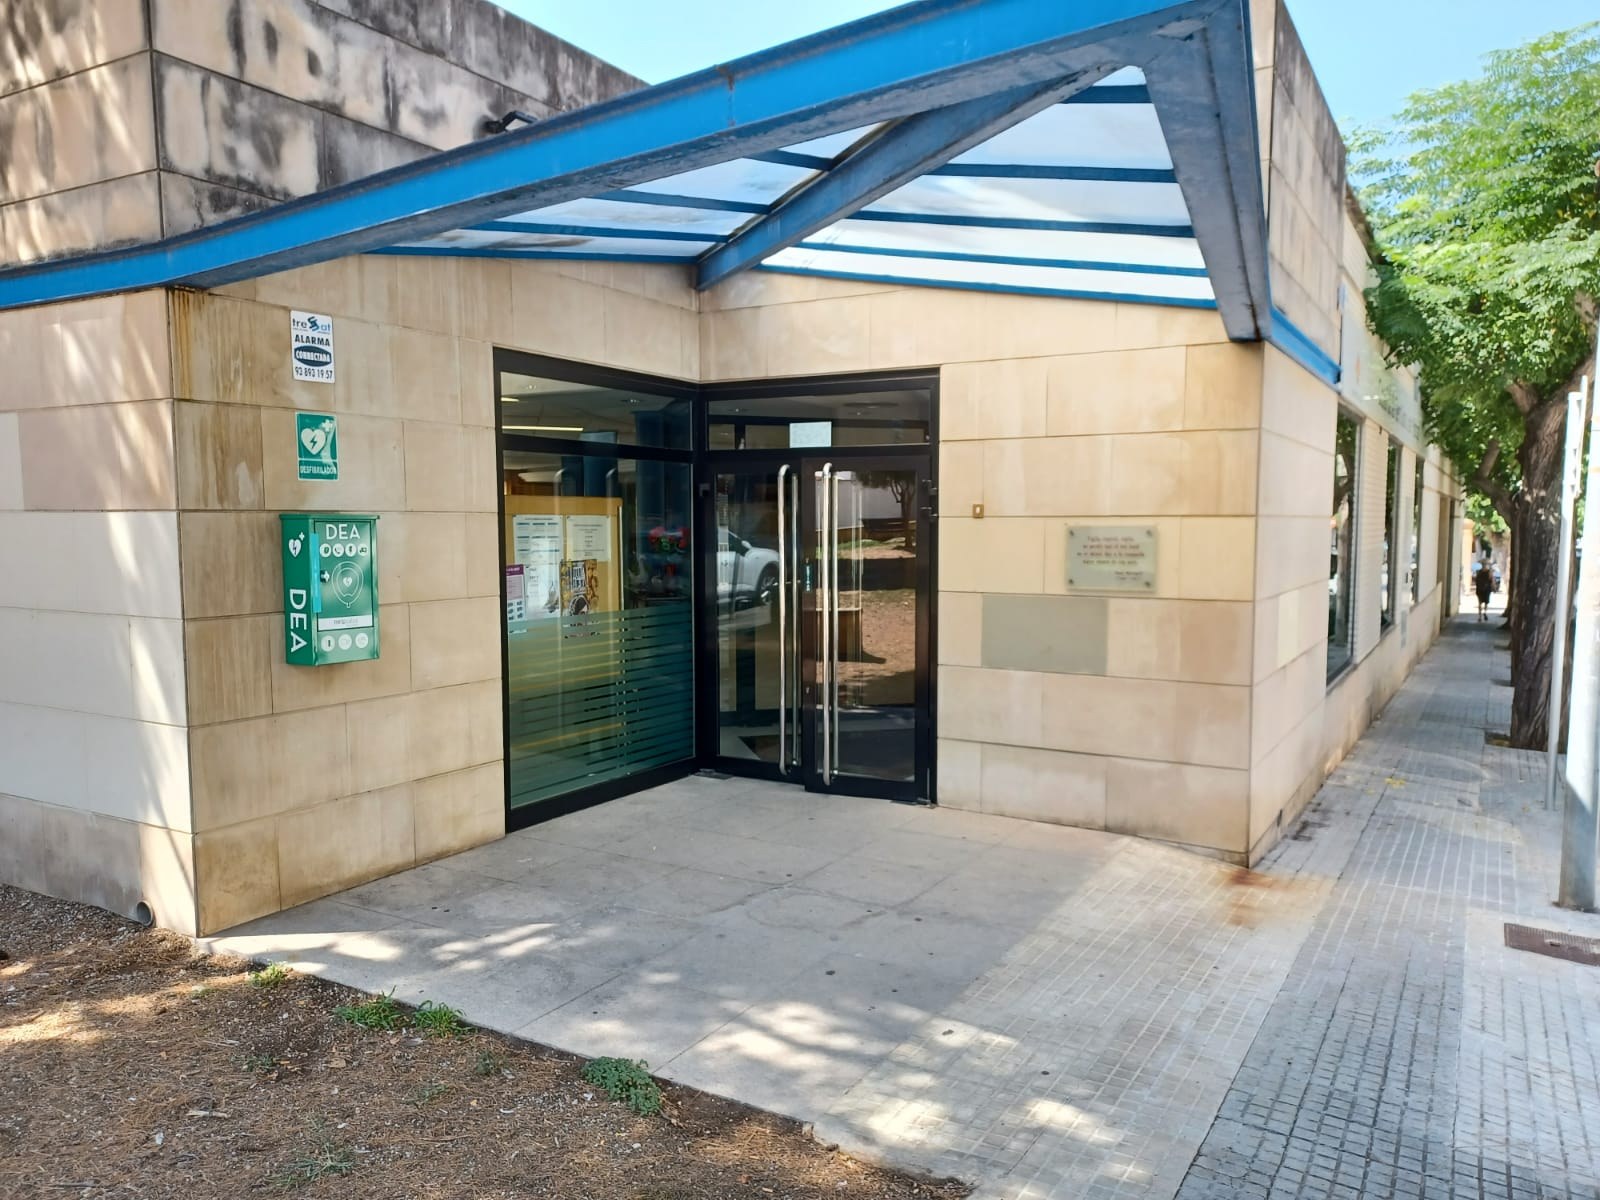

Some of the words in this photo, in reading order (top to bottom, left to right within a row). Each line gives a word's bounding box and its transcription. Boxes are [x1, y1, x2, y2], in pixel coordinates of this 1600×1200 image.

[295, 334, 331, 347] ALARMA
[295, 366, 303, 376] 93
[304, 367, 316, 378] 893
[317, 369, 324, 379] 19
[325, 370, 333, 380] 57
[326, 524, 361, 540] DEA
[289, 588, 308, 653] DEA
